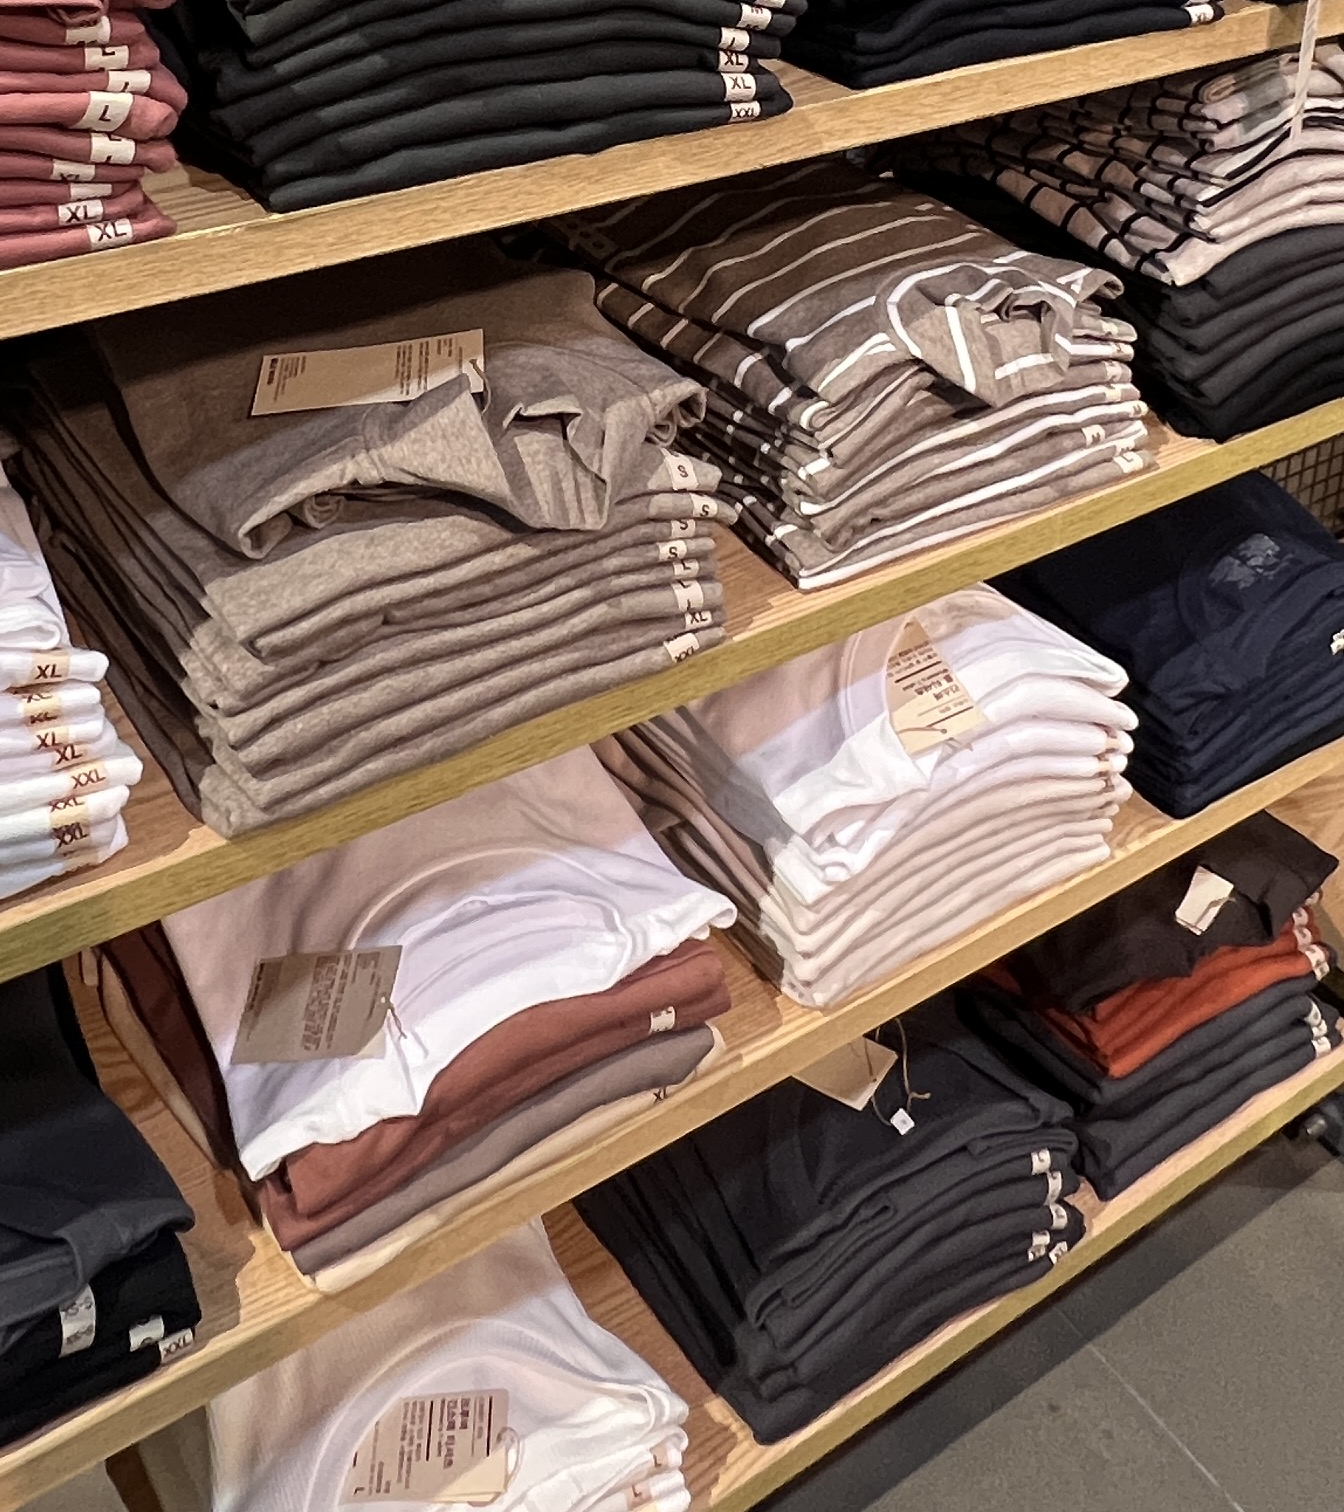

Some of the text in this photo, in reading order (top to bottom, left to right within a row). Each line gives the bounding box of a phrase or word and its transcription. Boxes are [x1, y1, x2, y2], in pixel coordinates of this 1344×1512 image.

[724, 51, 744, 66] XL
[730, 76, 752, 90] XL
[100, 105, 111, 122] L
[66, 205, 97, 223] XL
[95, 220, 128, 242] XL
[700, 504, 710, 517] S
[668, 546, 678, 560] S
[35, 664, 63, 680] XL
[36, 732, 64, 750] XL
[55, 744, 83, 765] XL
[71, 768, 107, 789] XXL
